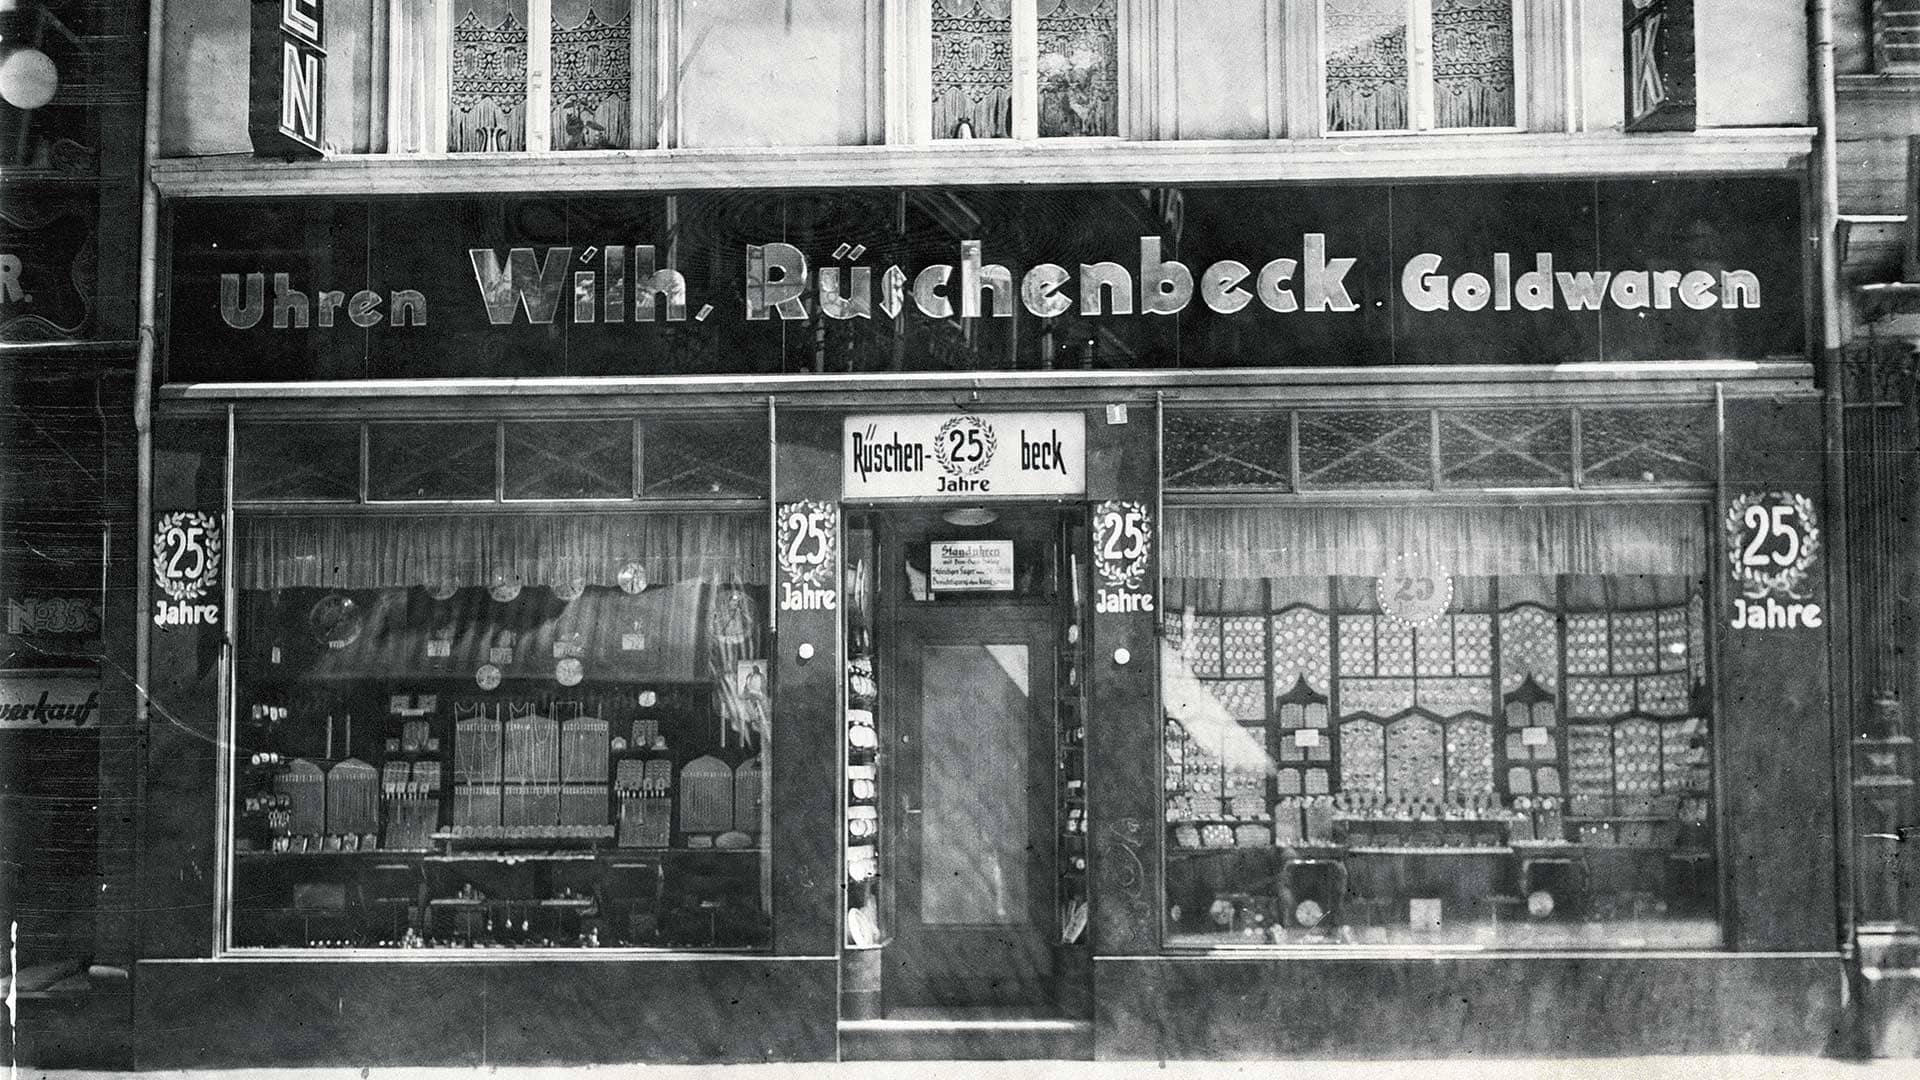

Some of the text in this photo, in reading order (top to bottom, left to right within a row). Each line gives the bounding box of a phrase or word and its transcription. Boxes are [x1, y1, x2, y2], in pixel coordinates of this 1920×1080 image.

[220, 272, 427, 330] Uhren
[746, 233, 1358, 323] Rüschenbeck
[1401, 252, 1761, 312] Goldwaren
[950, 429, 984, 462] 25
[1021, 429, 1067, 475] beck
[937, 476, 990, 492] Jahre
[167, 527, 204, 579] 25
[788, 512, 827, 564] 25
[1104, 512, 1144, 559] 25
[1743, 505, 1799, 566] 25
[154, 600, 218, 625] Jahre
[782, 582, 836, 611] Jahre
[1096, 588, 1154, 613] Jahre
[1731, 598, 1822, 629] Jahre
